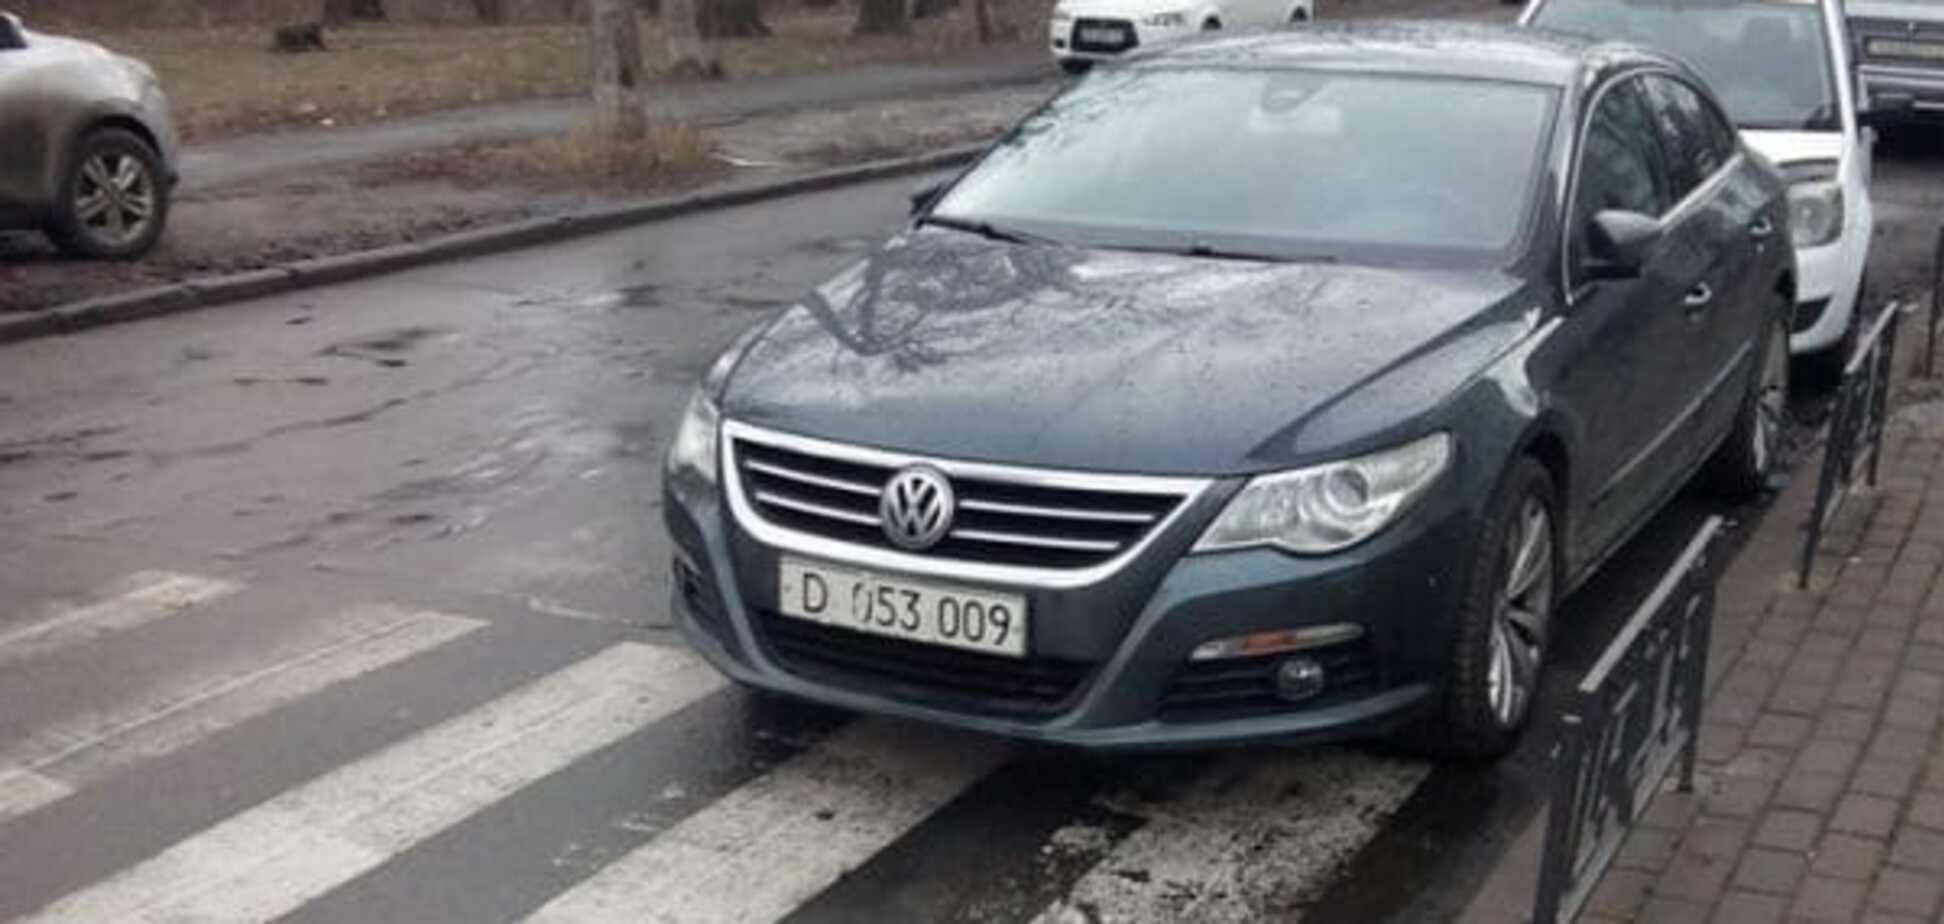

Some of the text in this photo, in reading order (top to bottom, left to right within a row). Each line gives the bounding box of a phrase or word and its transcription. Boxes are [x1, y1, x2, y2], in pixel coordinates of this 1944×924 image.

[883, 466, 950, 546] VW
[802, 572, 1011, 646] D 053 009
